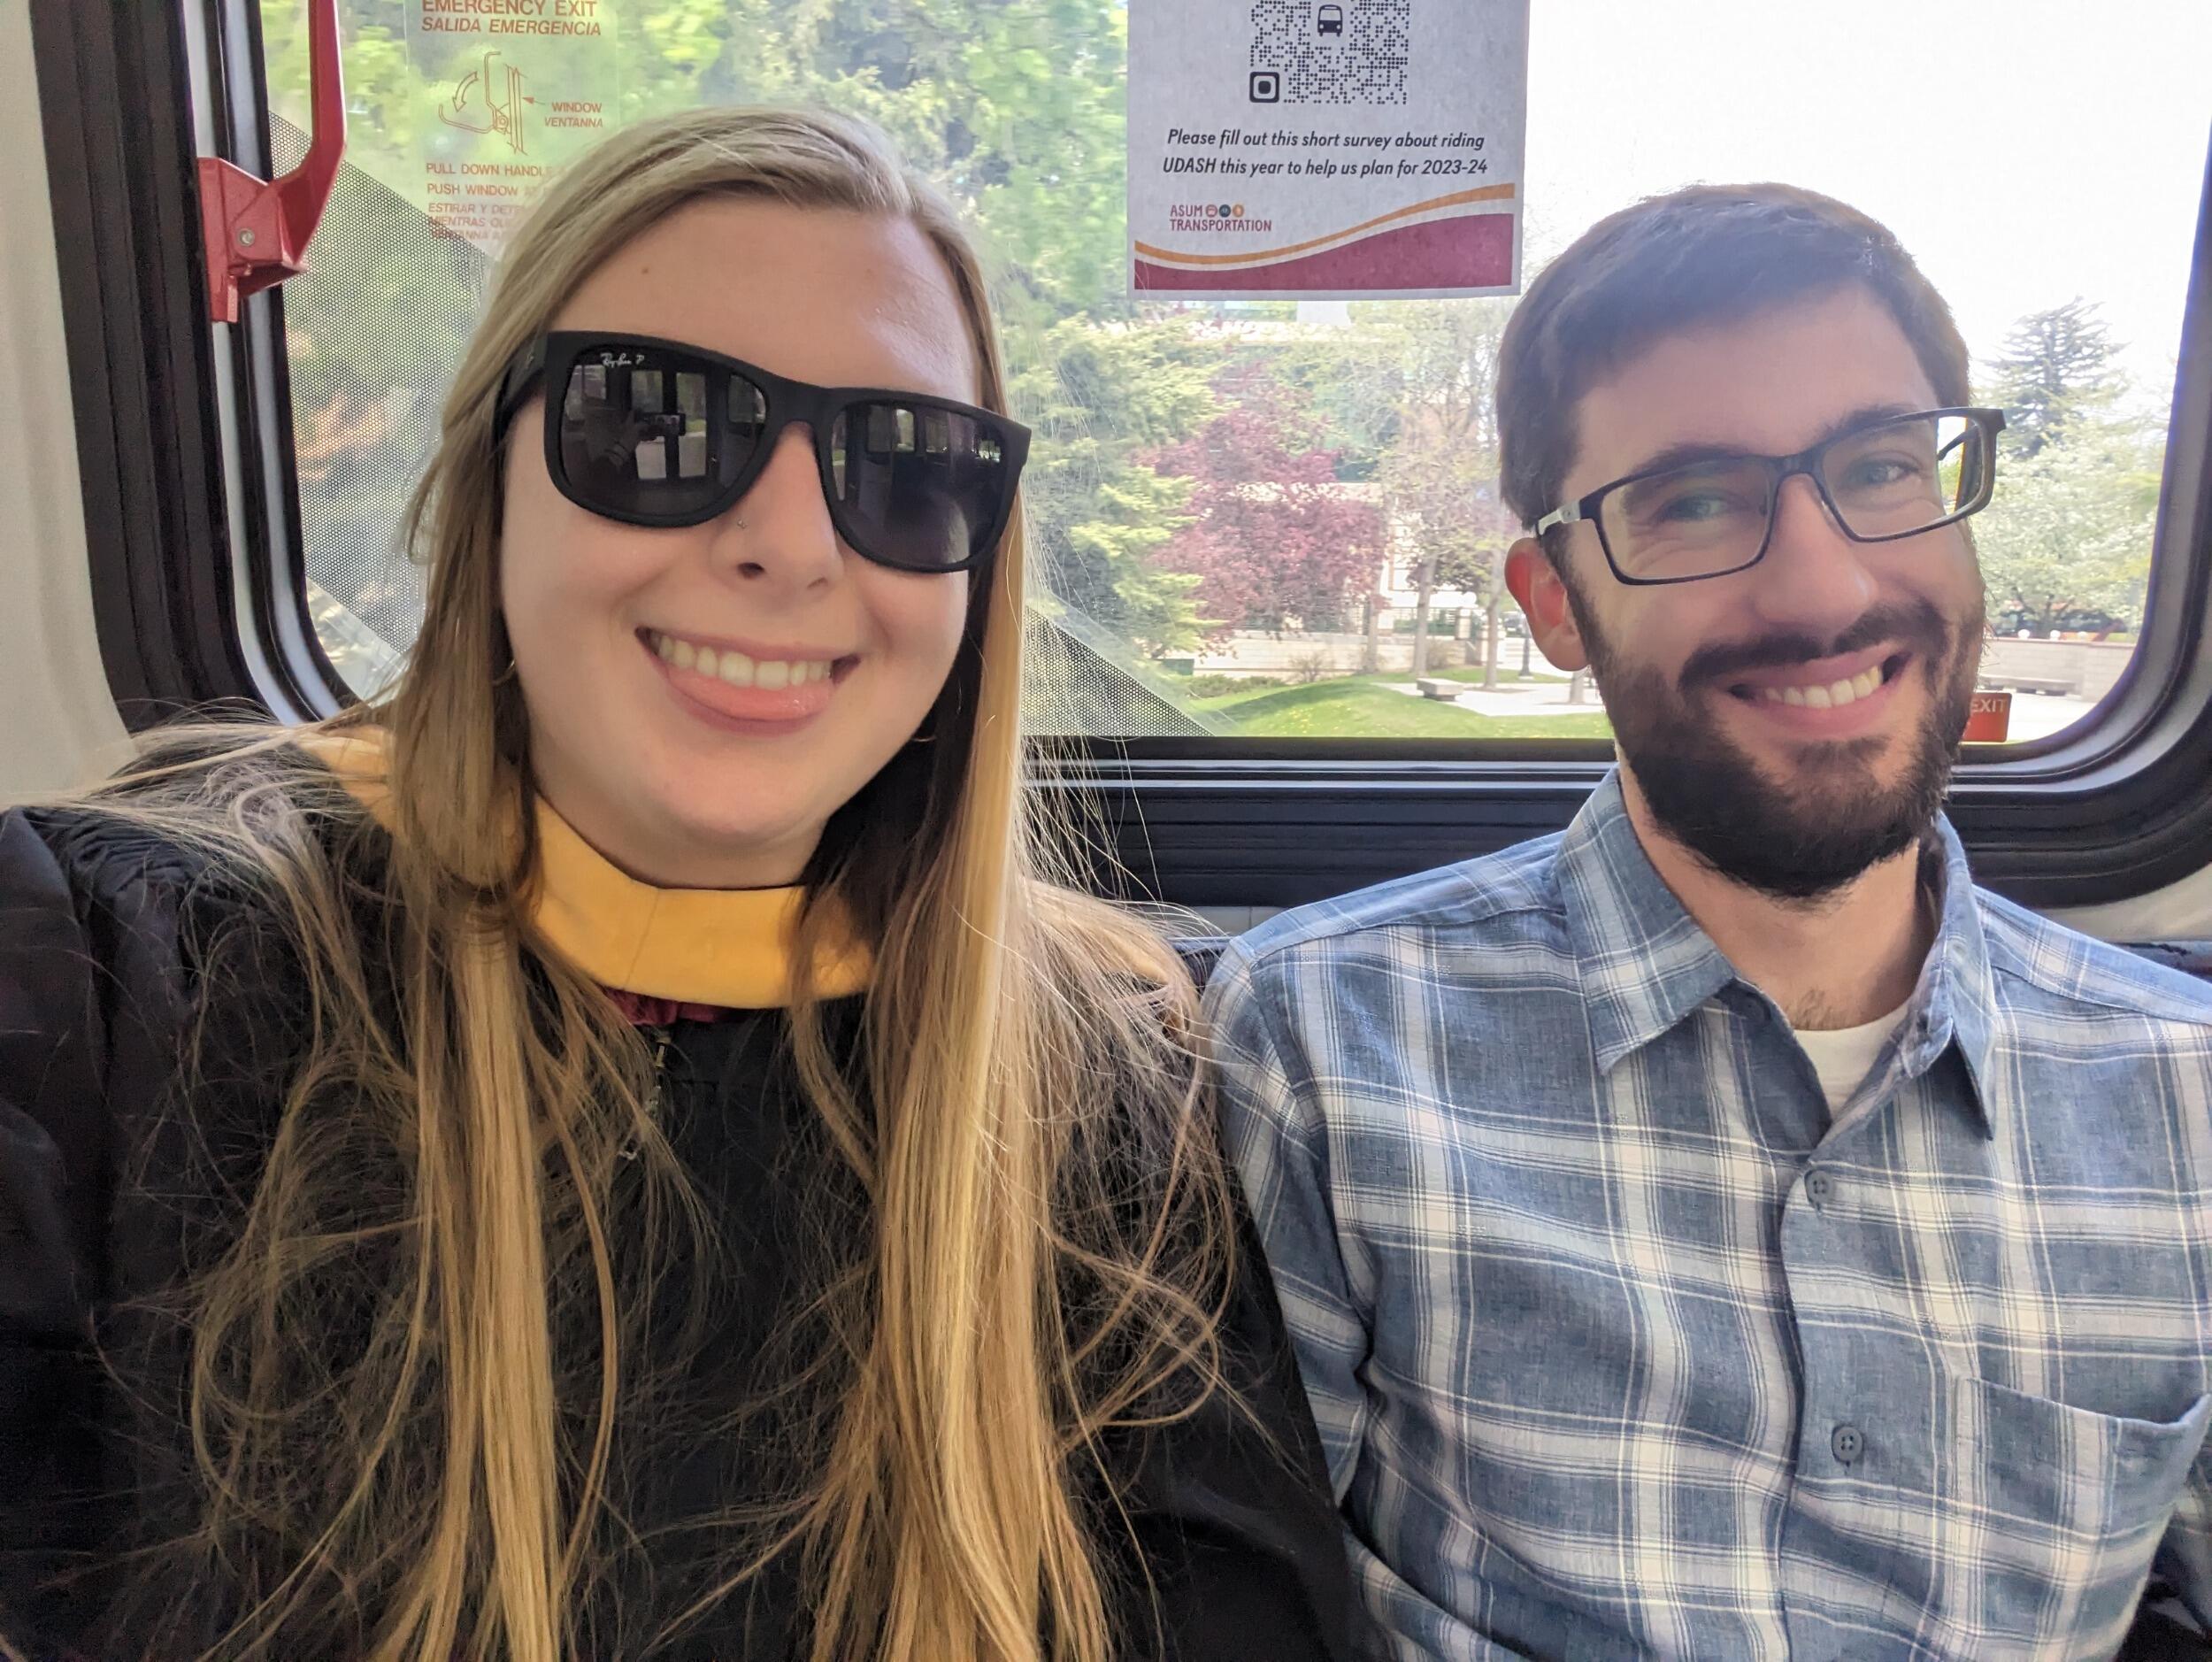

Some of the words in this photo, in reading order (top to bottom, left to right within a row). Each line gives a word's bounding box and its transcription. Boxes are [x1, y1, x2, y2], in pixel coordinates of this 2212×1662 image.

[422, 0, 545, 16] EMERGENCY
[555, 0, 597, 17] EXIT
[422, 17, 481, 33] SALIDA
[489, 19, 602, 35] EMERGENCIA
[551, 102, 603, 113] WINDOW
[544, 117, 603, 127] VENTANNA
[1167, 128, 1217, 145] Please
[1219, 129, 1240, 149] fill
[1243, 133, 1268, 146] out
[1271, 130, 1299, 147] this
[1302, 131, 1340, 147] short
[1343, 136, 1392, 150] survey
[1395, 132, 1438, 148] about
[1441, 133, 1485, 150] riding
[426, 163, 456, 174] PULL
[461, 164, 500, 175] DOWN
[1163, 158, 1217, 173] UDASH
[1220, 158, 1248, 174] this
[1249, 165, 1284, 178] year
[1287, 162, 1302, 174] to
[1305, 159, 1337, 179] help
[1340, 165, 1357, 175] us
[1360, 159, 1394, 179] plan
[1396, 160, 1419, 179] for
[1421, 159, 1488, 175] 2023-24
[427, 183, 460, 195] PUSH
[465, 184, 518, 196] WINDOW
[429, 203, 475, 213] ESTIRAR
[480, 204, 488, 213] Y
[1170, 204, 1202, 218] ASUM
[1170, 219, 1272, 232] TRANSPORTATION
[1970, 699, 2008, 712] EXIT
